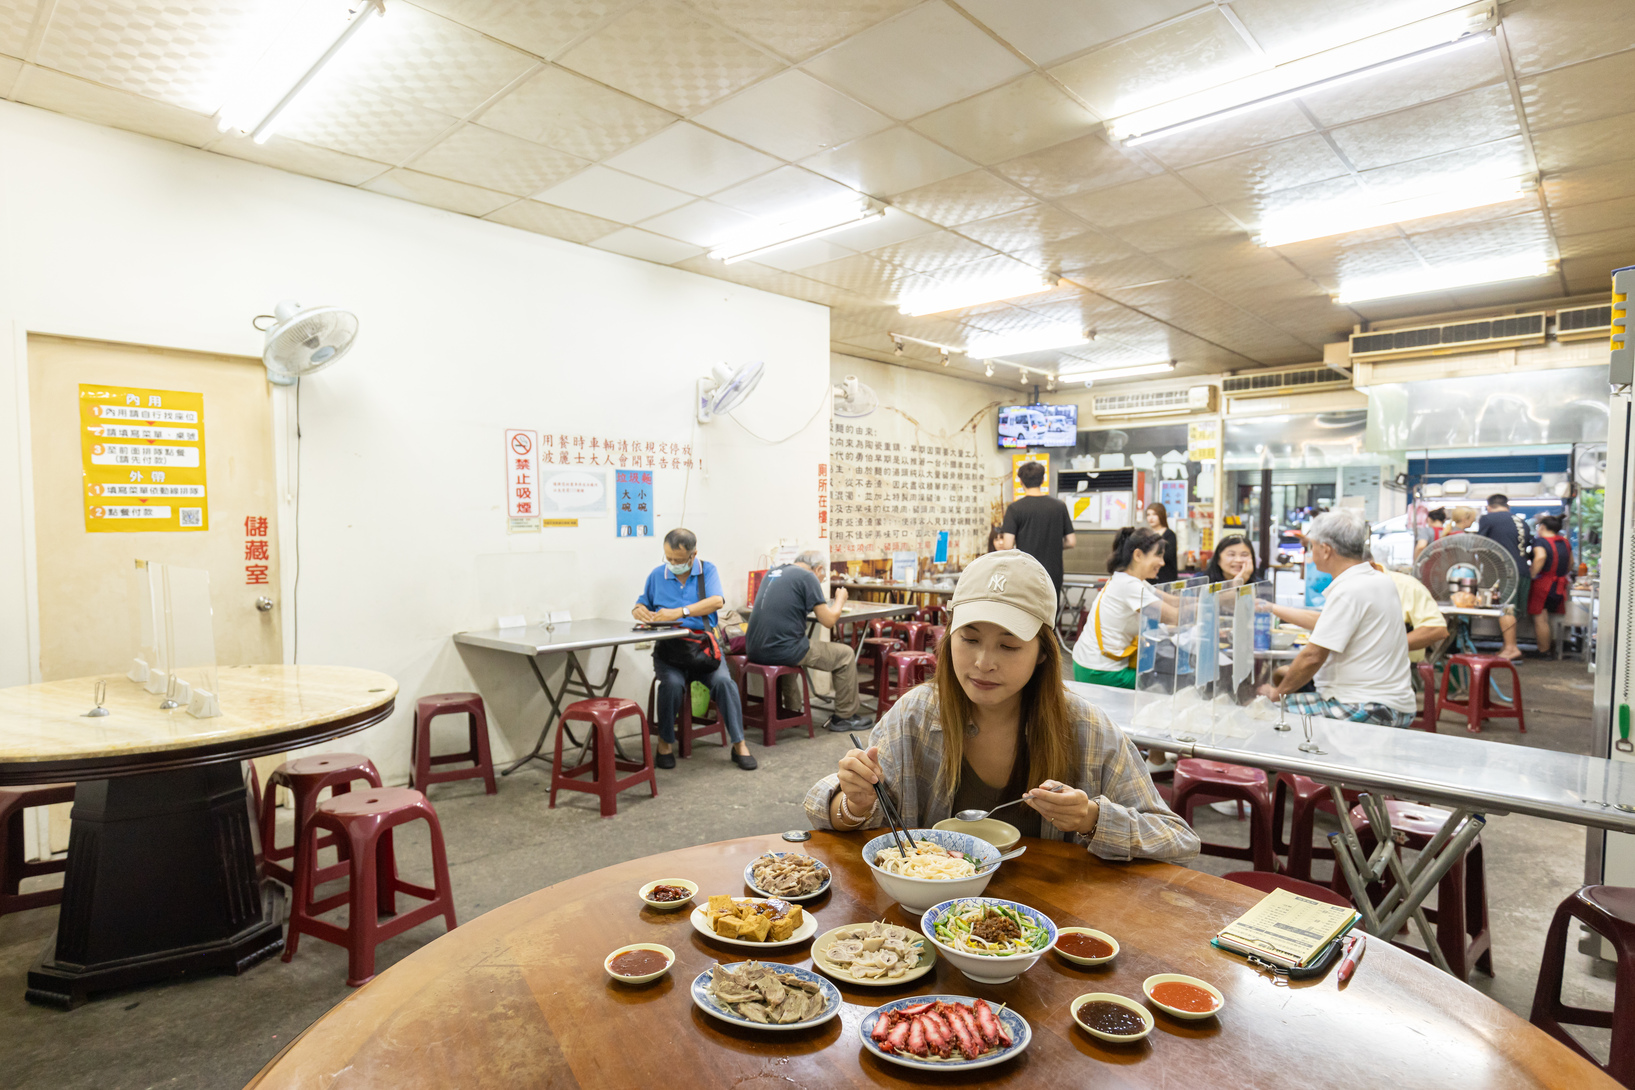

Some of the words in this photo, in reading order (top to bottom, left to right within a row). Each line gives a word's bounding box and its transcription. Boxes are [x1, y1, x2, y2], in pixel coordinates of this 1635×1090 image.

[126, 393, 162, 407] 內用
[105, 408, 195, 421] 內用請自行找座位
[106, 428, 196, 440] 請填寫菜單、桌號
[542, 434, 692, 455] 用餐時車輛請依規定停放
[107, 446, 185, 457] 至前面排隊點餐
[116, 456, 167, 465] (請先付款)
[129, 470, 165, 483] 外帶
[616, 472, 653, 485] 垃圾麵
[107, 486, 199, 495] 填寫菜單依動線排隊
[515, 458, 532, 514] 禁止吸煙
[621, 489, 632, 512] 大碗
[637, 489, 648, 512] 小碗
[818, 463, 828, 539] 廁所在樓上
[107, 508, 153, 517] 點餐付款
[244, 516, 269, 585] 儲藏室
[988, 574, 1007, 592] NY
